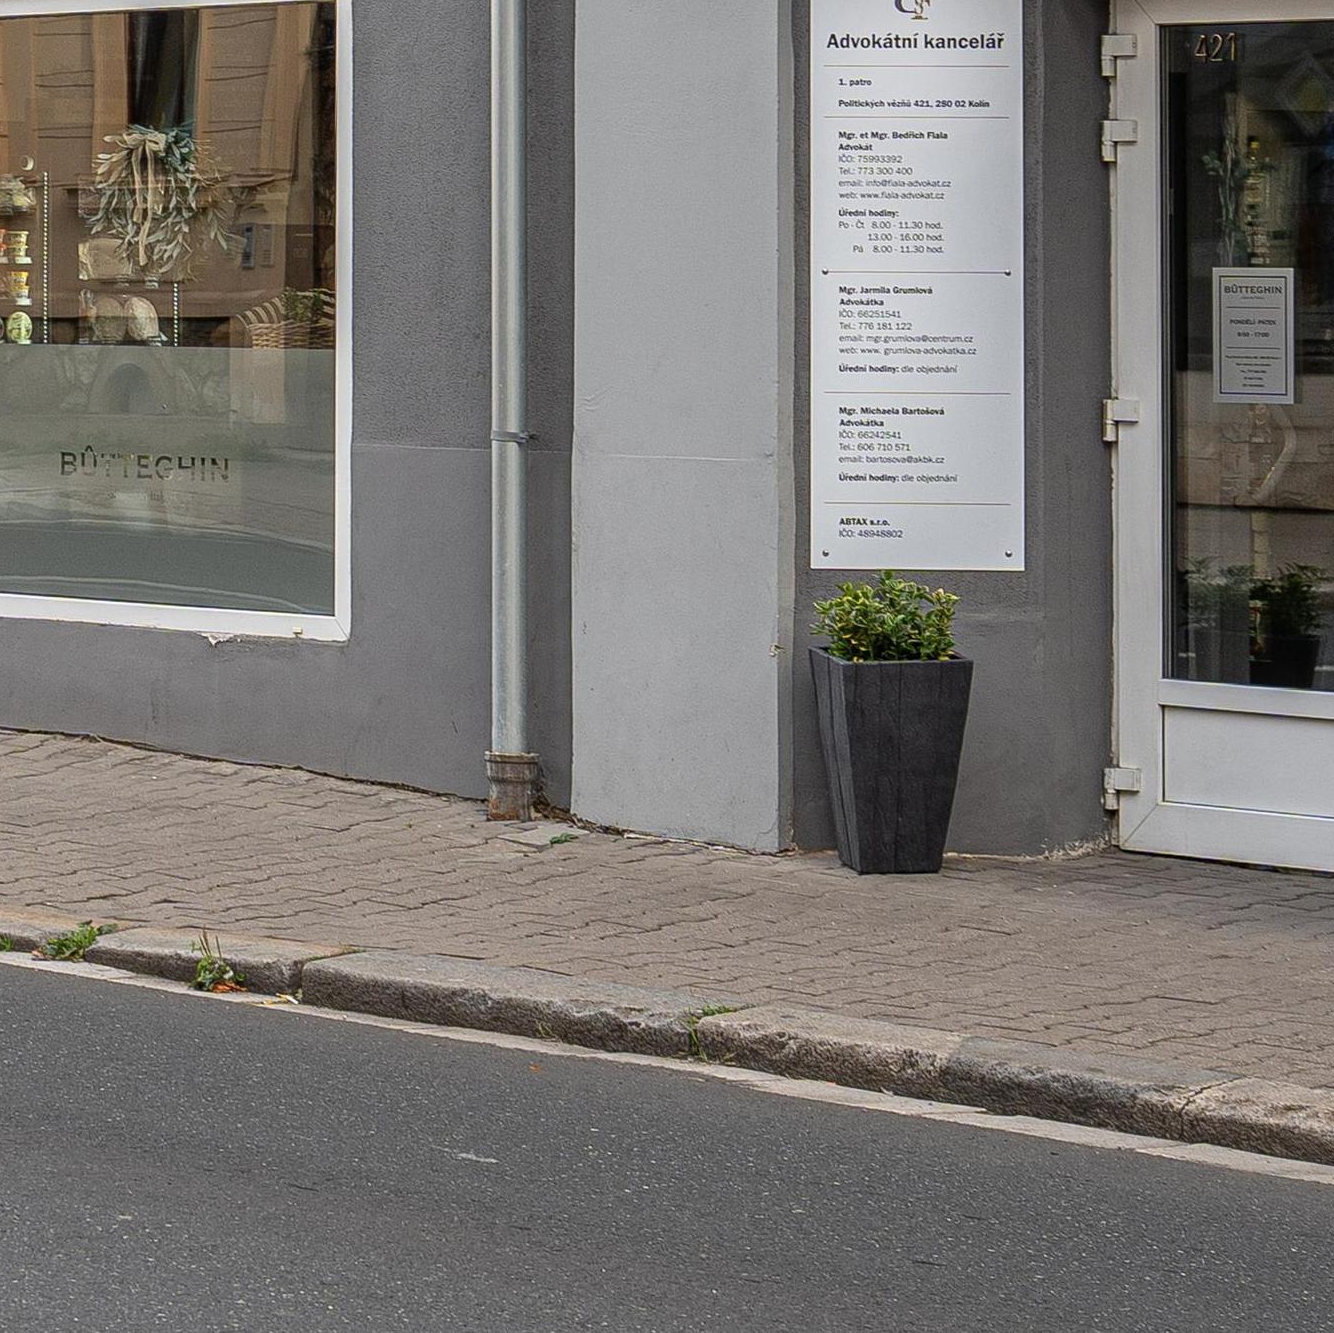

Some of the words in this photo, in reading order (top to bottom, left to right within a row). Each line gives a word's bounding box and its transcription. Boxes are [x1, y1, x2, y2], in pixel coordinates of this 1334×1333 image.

[826, 33, 919, 49] Advokátní
[924, 33, 1004, 49] kancelář
[1193, 32, 1237, 63] 421
[838, 78, 847, 86] 1.
[849, 78, 872, 87] patro
[838, 99, 885, 109] Politických
[913, 100, 933, 109] 421,
[935, 100, 953, 108] 280
[955, 100, 966, 108] 02
[968, 99, 990, 108] Kolín
[838, 131, 857, 140] Mgr.
[860, 132, 869, 140] et
[871, 131, 890, 140] Mgr.
[892, 131, 925, 140] Bedřich
[927, 131, 948, 140] Fiala
[838, 143, 873, 151] Advokát
[838, 155, 854, 163] IČO:
[839, 167, 854, 175] Tel.:
[857, 167, 874, 175] 773
[877, 167, 894, 175] 300
[895, 167, 913, 175] 400
[838, 180, 864, 188] email:
[866, 180, 952, 188] info@fiala-advokat.cz
[838, 192, 858, 200] web:
[860, 192, 945, 200] www.fiala-advokat.cz
[838, 207, 867, 217] Úřední
[869, 209, 899, 219] hodiny:
[838, 221, 850, 229] Po
[855, 220, 865, 229] Čt
[871, 221, 891, 229] 8.00
[899, 221, 923, 229] 11.30
[925, 221, 944, 229] hod.
[868, 233, 893, 241] 13.00
[900, 233, 924, 241] 16.00
[926, 233, 945, 241] hod.
[853, 244, 864, 253] Pá
[872, 245, 893, 253] 8.00
[900, 245, 925, 253] 11.30
[926, 245, 945, 253] hod.
[839, 286, 858, 295] Mgr.
[860, 286, 891, 295] Jarmila
[893, 286, 933, 295] Grumlová
[1224, 284, 1283, 294] BÛTTEGHIN
[839, 298, 884, 306] Advokátka
[838, 308, 856, 318] IČO:
[839, 322, 855, 330] Tel.:
[858, 322, 874, 330] 776
[877, 322, 893, 330] 181
[895, 322, 912, 330] 122
[839, 335, 864, 343] email:
[866, 335, 974, 344] mgr.grumlova@centrum.cz
[839, 347, 858, 355] web:
[838, 363, 867, 373] Úřední
[869, 365, 899, 374] hodiny:
[901, 365, 914, 373] dle
[916, 365, 958, 375] objednání
[839, 407, 858, 416] Mgr.
[860, 406, 900, 415] Michaela
[902, 406, 945, 416] Bartošová
[839, 418, 884, 427] Advokátka
[838, 430, 855, 439] IČO:
[839, 443, 855, 451] Tel.:
[857, 443, 875, 451] 606
[877, 443, 893, 451] 710
[895, 443, 911, 451] 571
[838, 455, 864, 464] email:
[866, 455, 945, 464] bartosova@akbk.cz
[838, 472, 867, 482] Úřední
[869, 474, 899, 483] hodiny:
[901, 474, 914, 482] dle
[916, 474, 958, 484] objednání
[838, 528, 856, 538] IČO:
